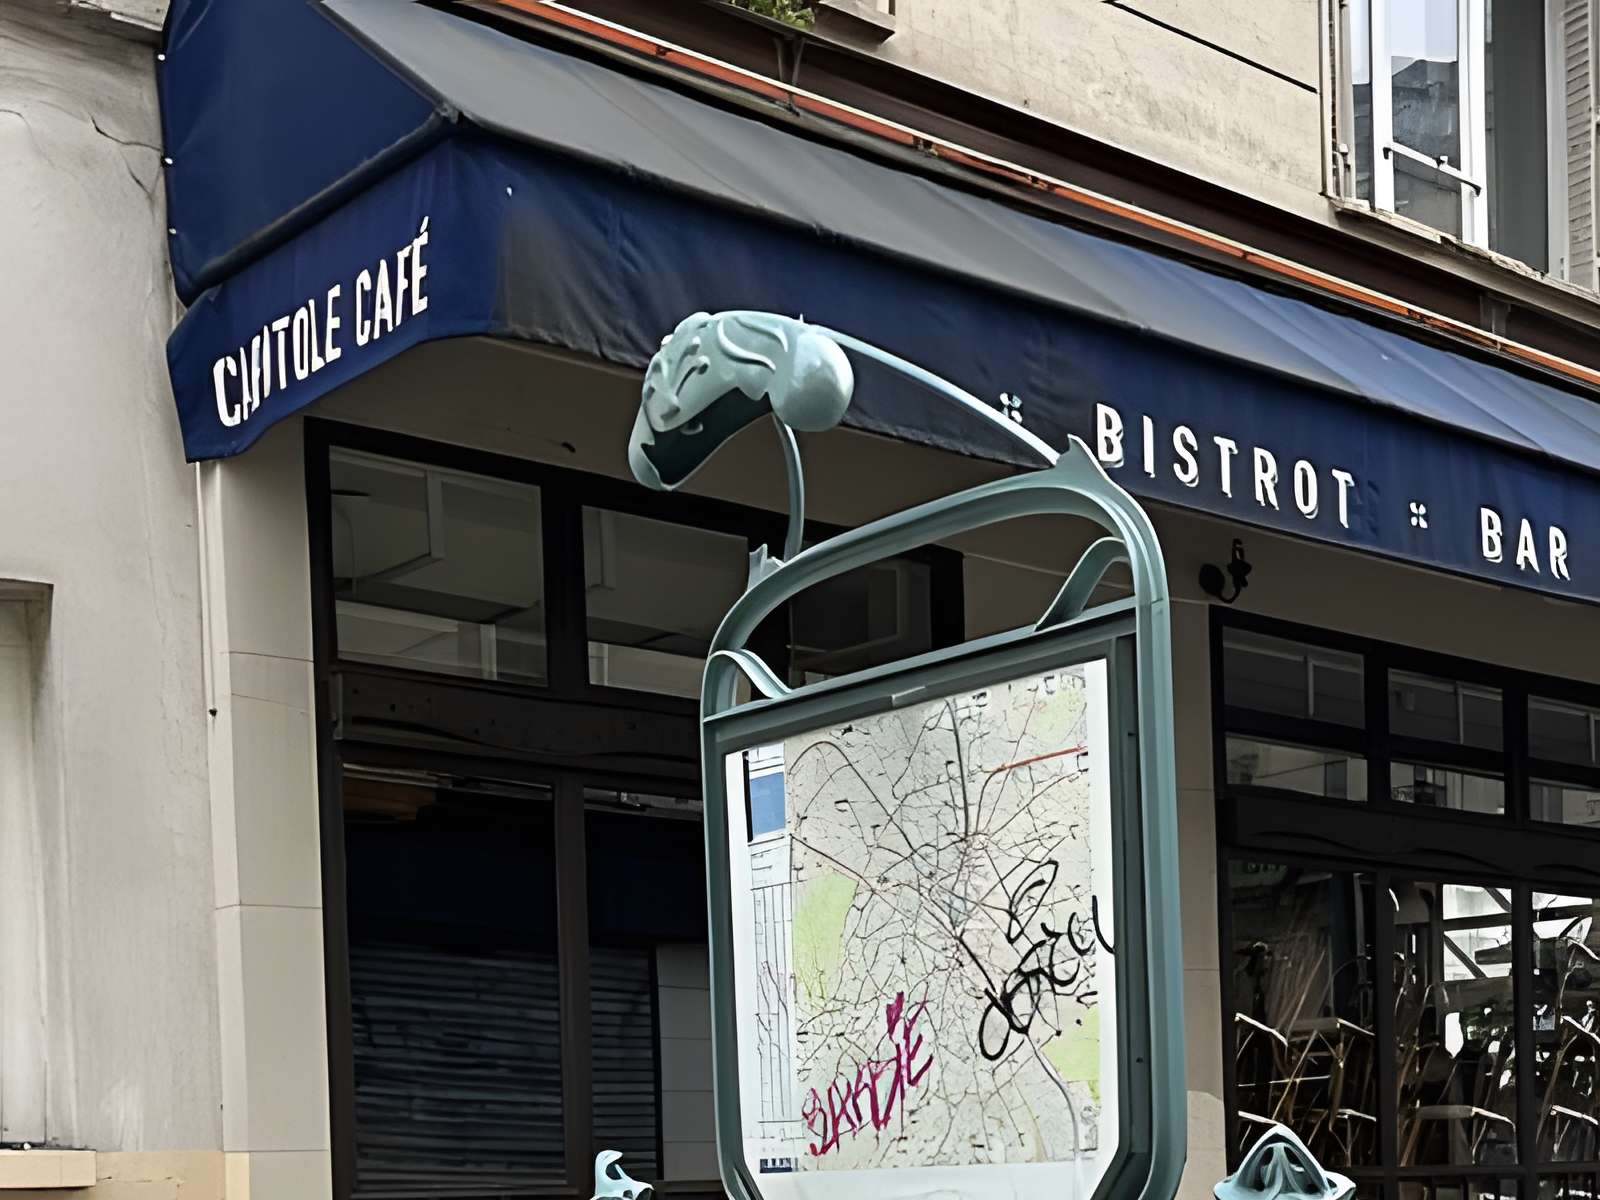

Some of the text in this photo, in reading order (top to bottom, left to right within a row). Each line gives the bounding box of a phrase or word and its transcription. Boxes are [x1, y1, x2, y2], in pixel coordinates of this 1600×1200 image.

[355, 215, 430, 347] CAFÉ
[1096, 402, 1355, 529] BISTROT
[1480, 506, 1572, 582] BAR
